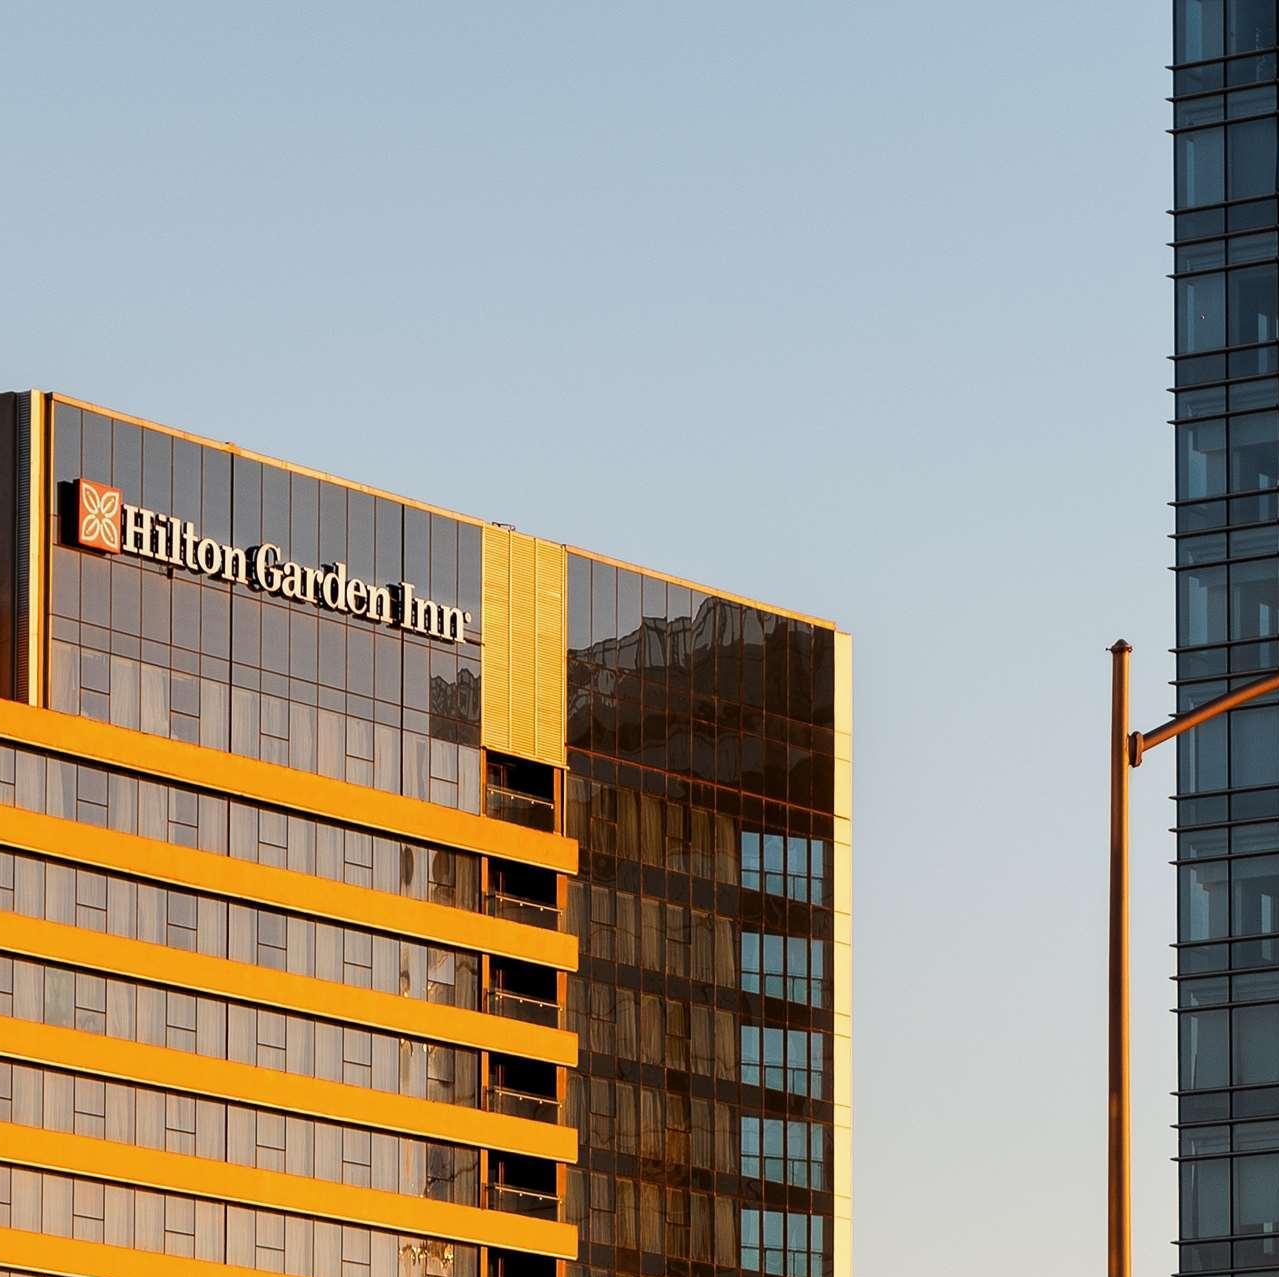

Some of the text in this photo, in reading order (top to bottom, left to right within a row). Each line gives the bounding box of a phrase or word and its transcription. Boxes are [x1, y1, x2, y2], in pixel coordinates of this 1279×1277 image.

[122, 503, 467, 644] Hilton Garden Inn
